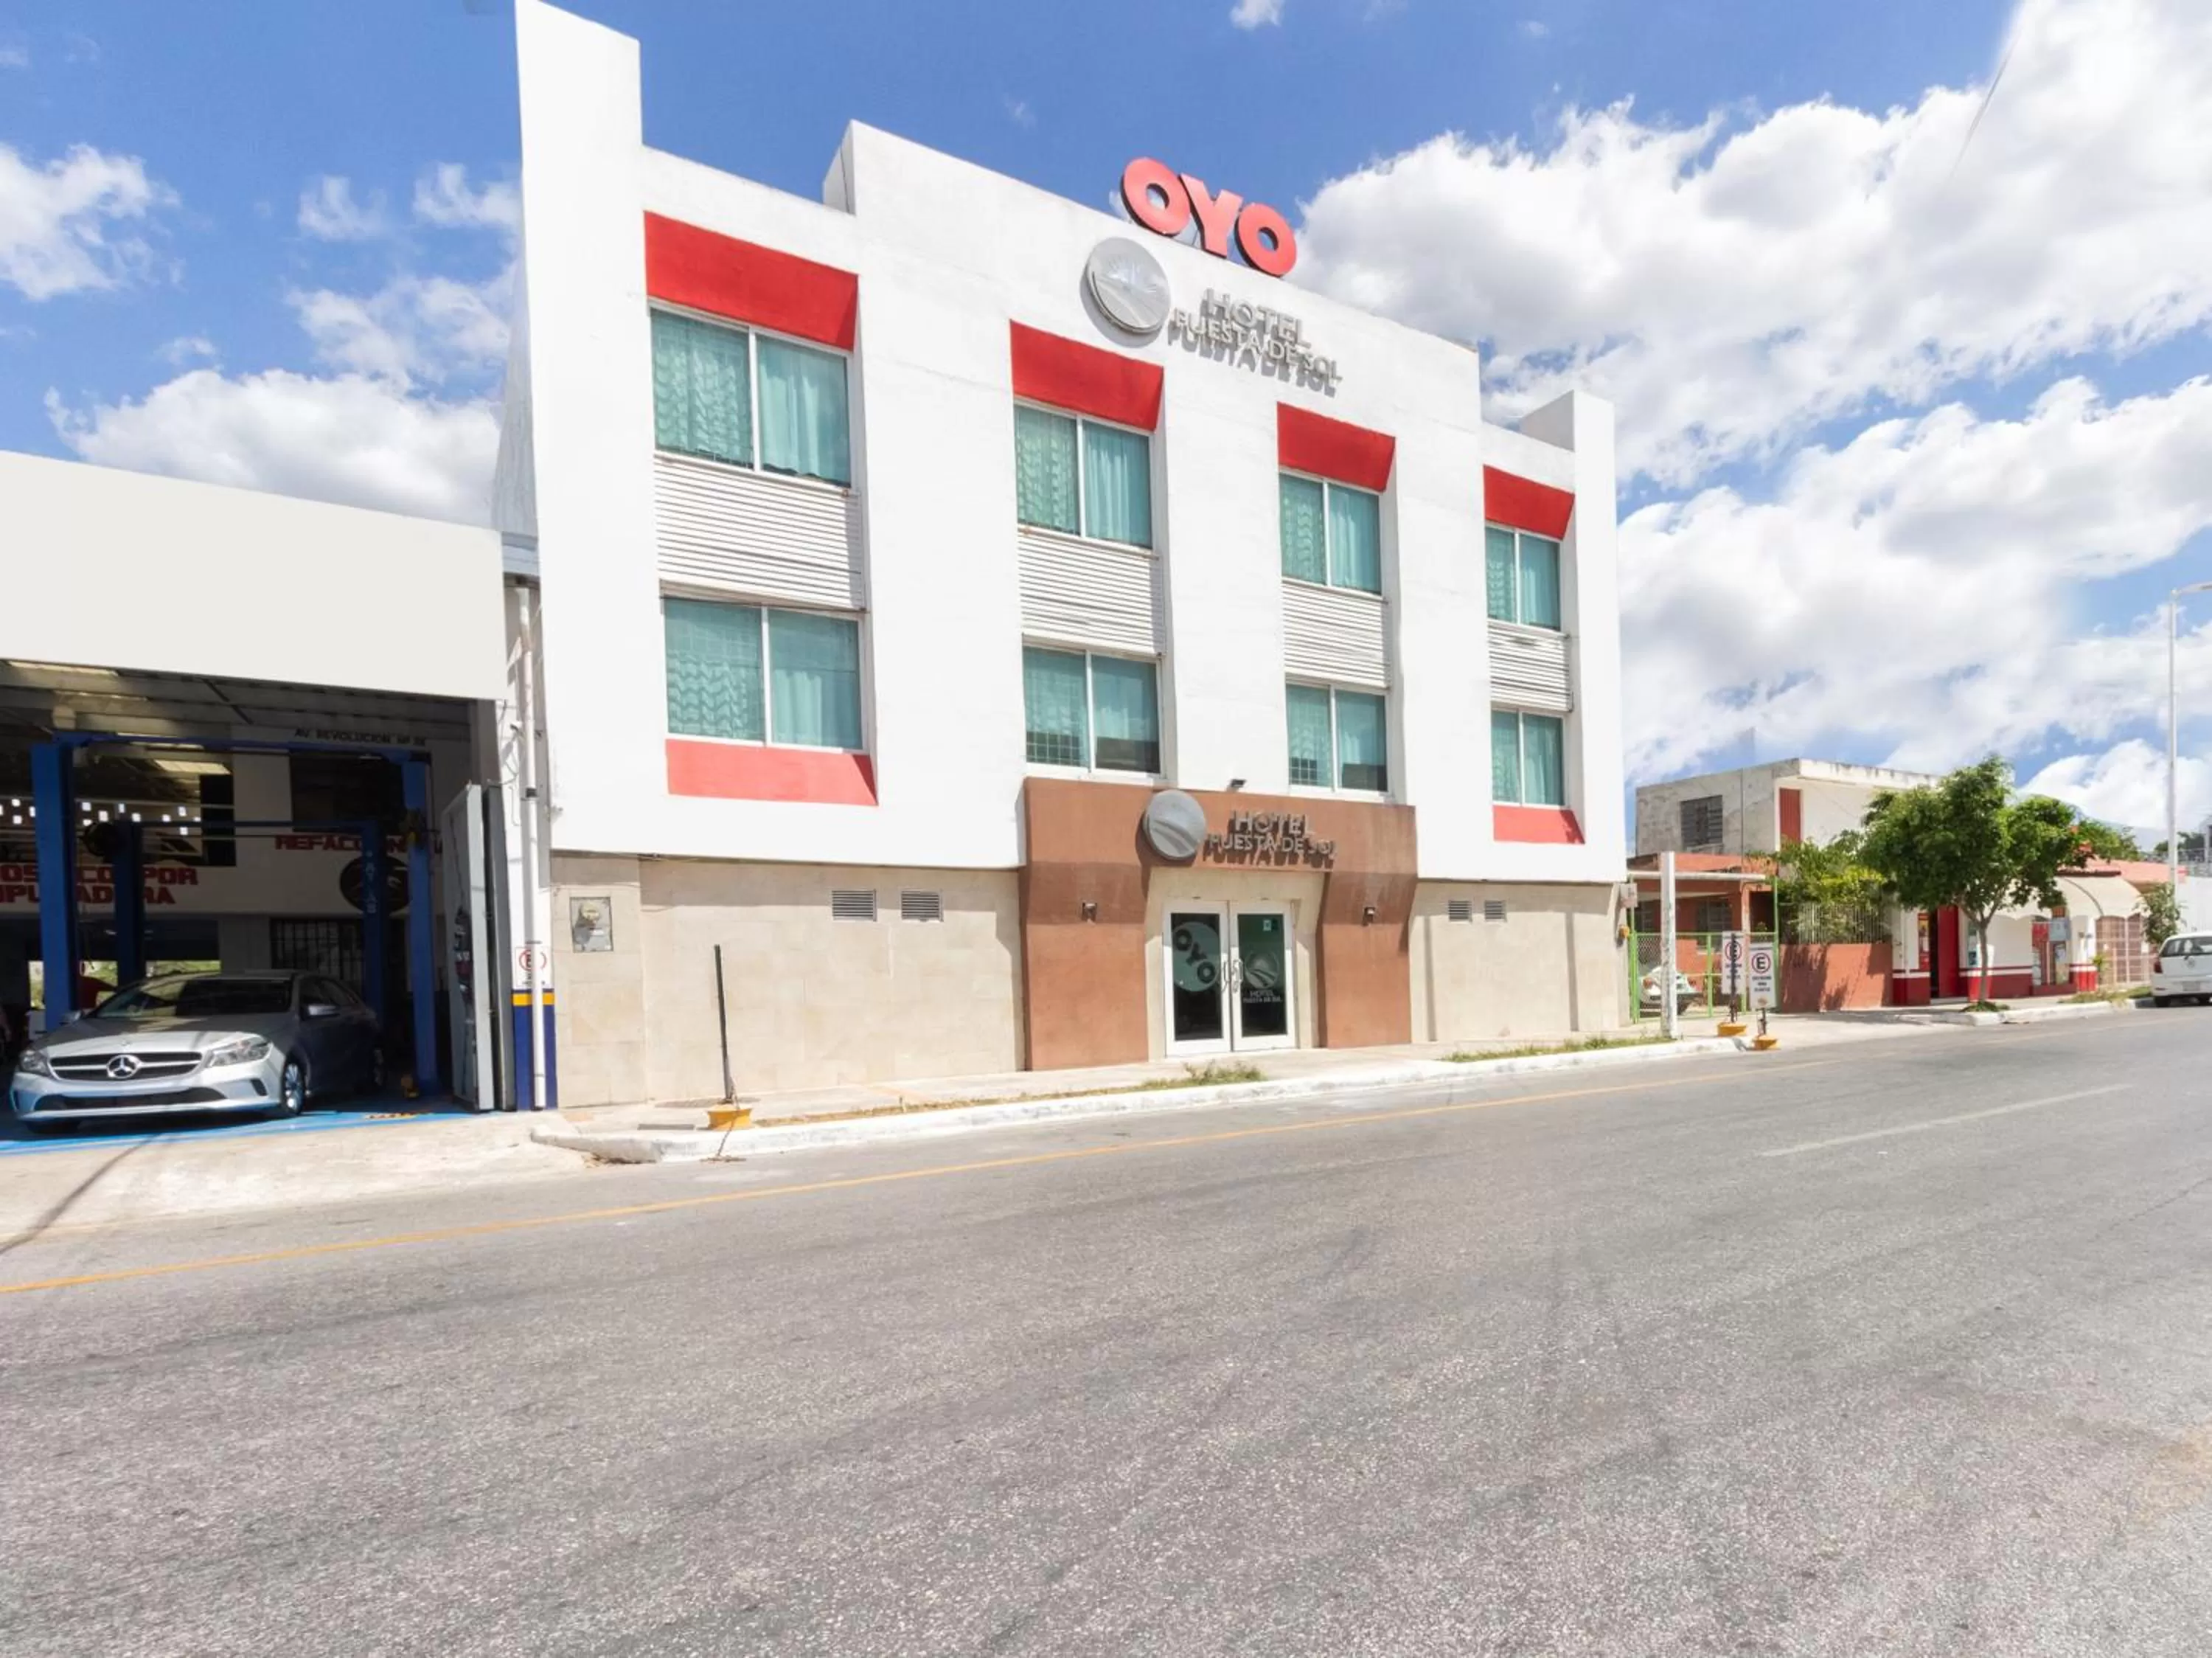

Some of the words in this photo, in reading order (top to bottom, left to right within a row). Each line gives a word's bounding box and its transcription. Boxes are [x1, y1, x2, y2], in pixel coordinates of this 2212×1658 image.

[1121, 156, 1297, 277] OYO
[1173, 307, 1264, 356] PUESTA
[1267, 339, 1298, 367] DE
[1299, 351, 1343, 384] SOL
[1203, 287, 1312, 349] HOTEL
[1208, 832, 1278, 851] PUESTA
[1281, 836, 1305, 853] DE
[1234, 811, 1315, 837] HOTEL
[1173, 929, 1216, 984] OYO
[1756, 957, 1765, 969] E
